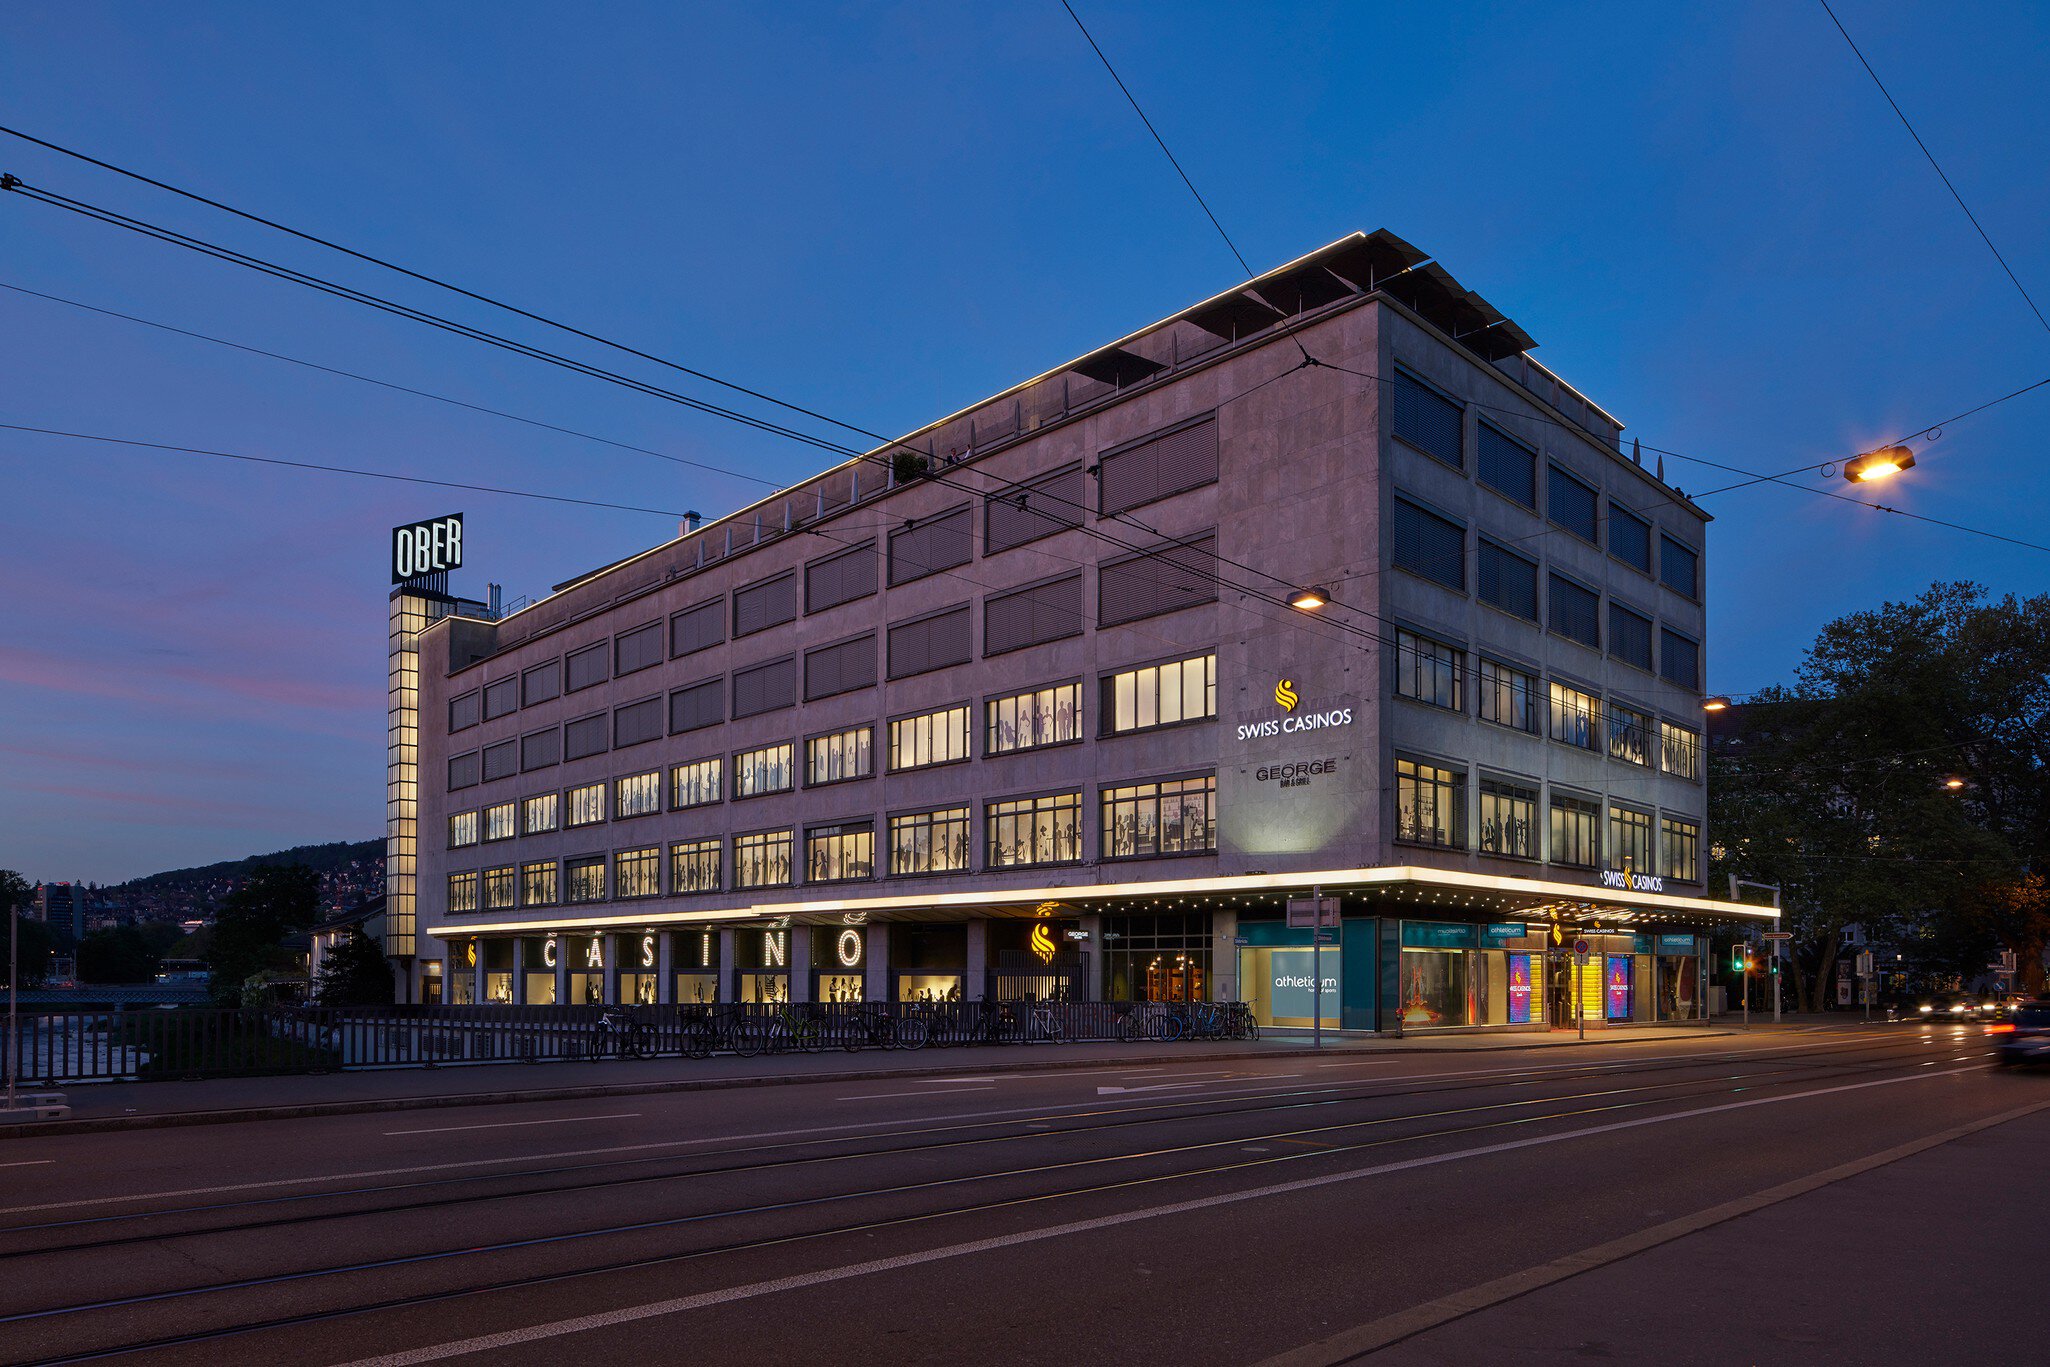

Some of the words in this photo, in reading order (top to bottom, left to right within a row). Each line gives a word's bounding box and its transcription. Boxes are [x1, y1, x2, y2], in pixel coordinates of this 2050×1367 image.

[397, 518, 461, 577] OBER
[1237, 720, 1279, 740] SWISS
[1283, 708, 1352, 733] CASINOS
[1256, 758, 1337, 781] GEORGE
[1603, 870, 1625, 888] SWISS
[1632, 874, 1663, 892] CASINOS
[1490, 926, 1522, 934] athleticum
[544, 930, 862, 967] CASINO
